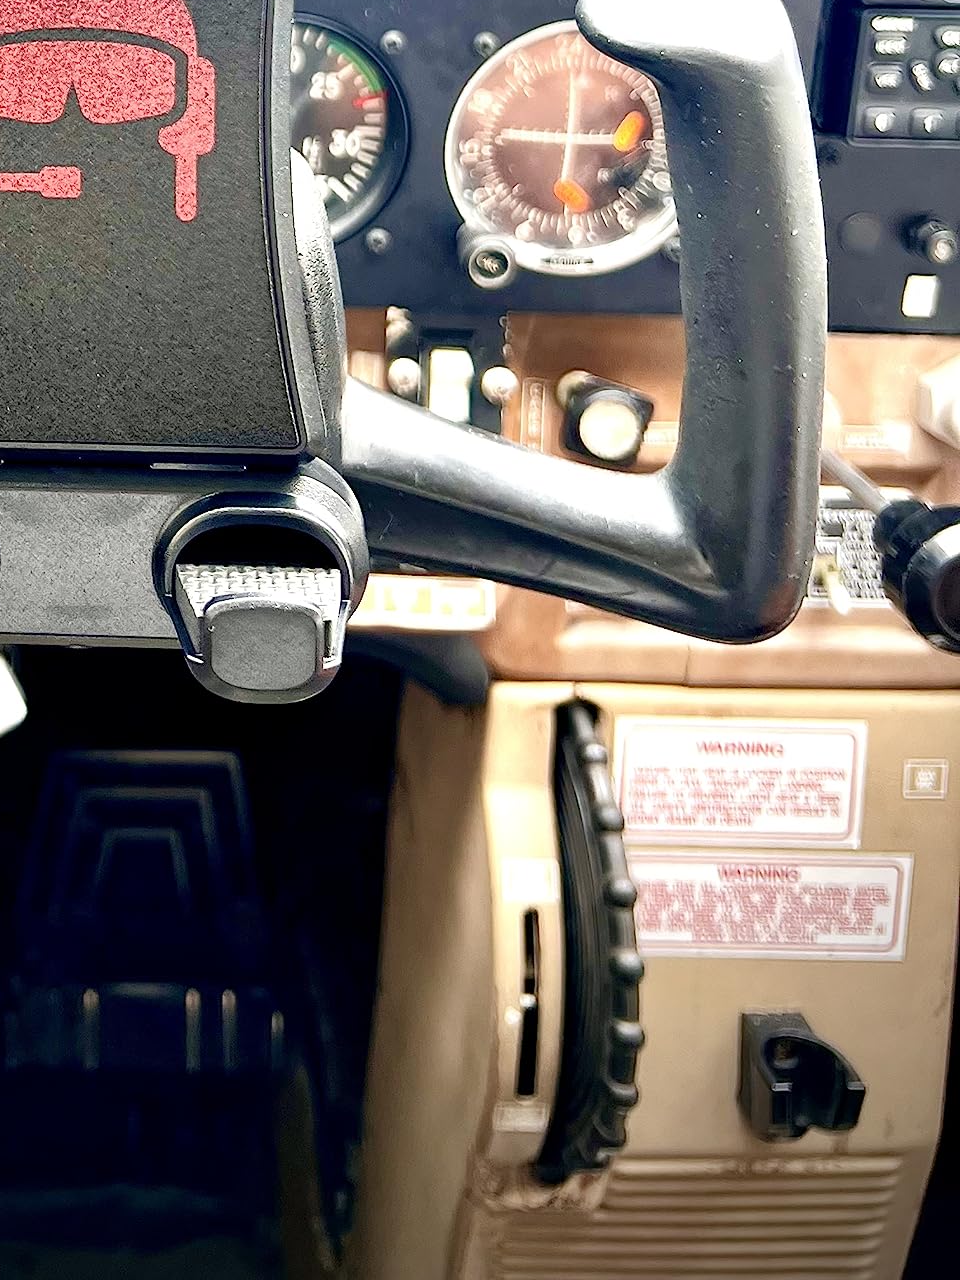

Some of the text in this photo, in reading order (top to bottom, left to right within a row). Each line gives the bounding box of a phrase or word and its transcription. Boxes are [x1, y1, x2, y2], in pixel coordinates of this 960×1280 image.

[328, 128, 362, 158] 30
[696, 740, 785, 758] WARNING
[718, 866, 801, 883] WARNING
